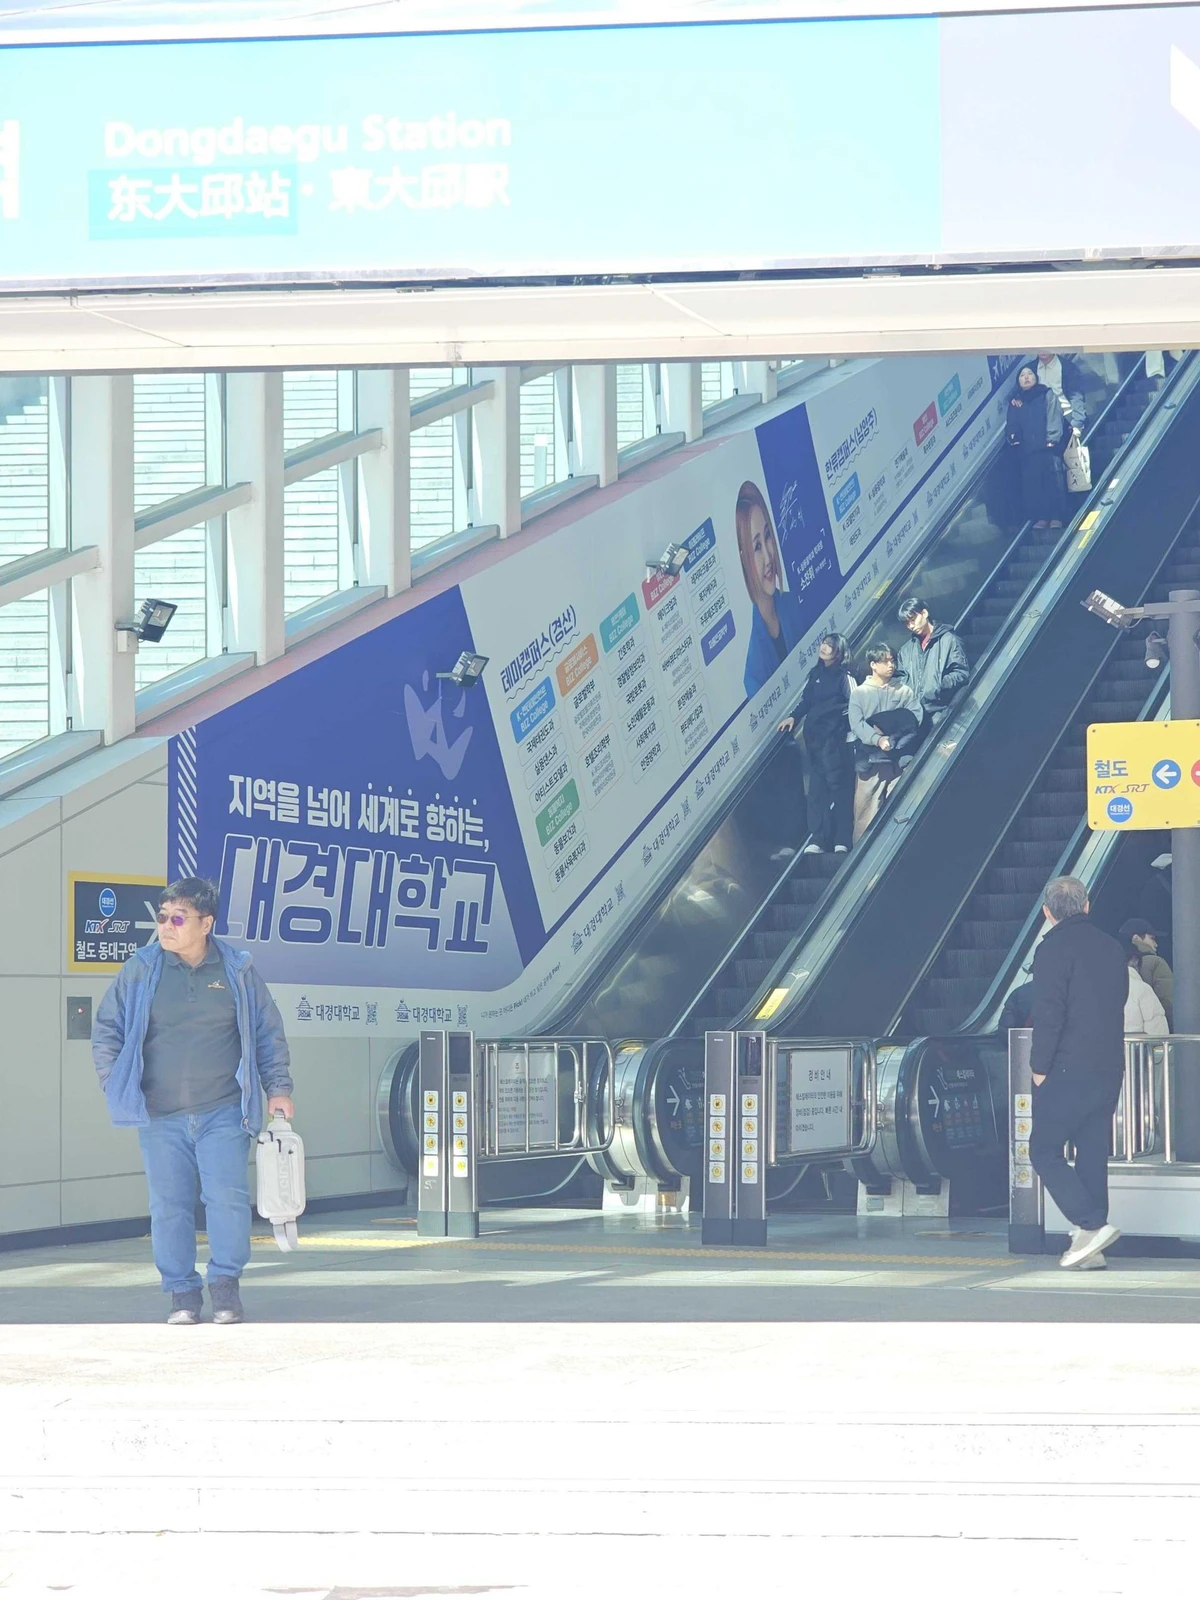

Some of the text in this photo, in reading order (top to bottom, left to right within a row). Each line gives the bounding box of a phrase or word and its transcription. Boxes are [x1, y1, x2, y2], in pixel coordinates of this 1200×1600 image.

[105, 111, 511, 163] Dongdaegu Station
[108, 170, 290, 223] 东大邱站
[825, 407, 878, 481] 한류캠퍼스(남양주)
[500, 604, 577, 693] 테마캠퍼스(경산)
[530, 702, 549, 723] College
[526, 718, 556, 753] 국제태권도과
[584, 734, 611, 769] 호텔조리학부
[635, 720, 657, 749] 사회복지과
[534, 744, 558, 776] 실용댄스과
[704, 750, 731, 785] 대경대학교
[1094, 760, 1128, 778] 철도
[534, 762, 569, 803] 아티스트모델과
[1095, 783, 1150, 794] KTX SRT
[228, 774, 490, 852] 지역을 넘어 세계로 향하는,
[545, 802, 574, 835] BIZ College
[1110, 804, 1130, 812] 대경선
[553, 823, 577, 855] 동물보건과
[653, 813, 681, 852] 대경대학교
[212, 833, 498, 954] 대경대학교
[85, 918, 130, 934] KTX SRT
[583, 899, 614, 938] 대경대학교
[76, 941, 137, 960] 철도 동대구역
[315, 1004, 360, 1021] 대경대학교
[412, 1006, 452, 1023] 대경대학교
